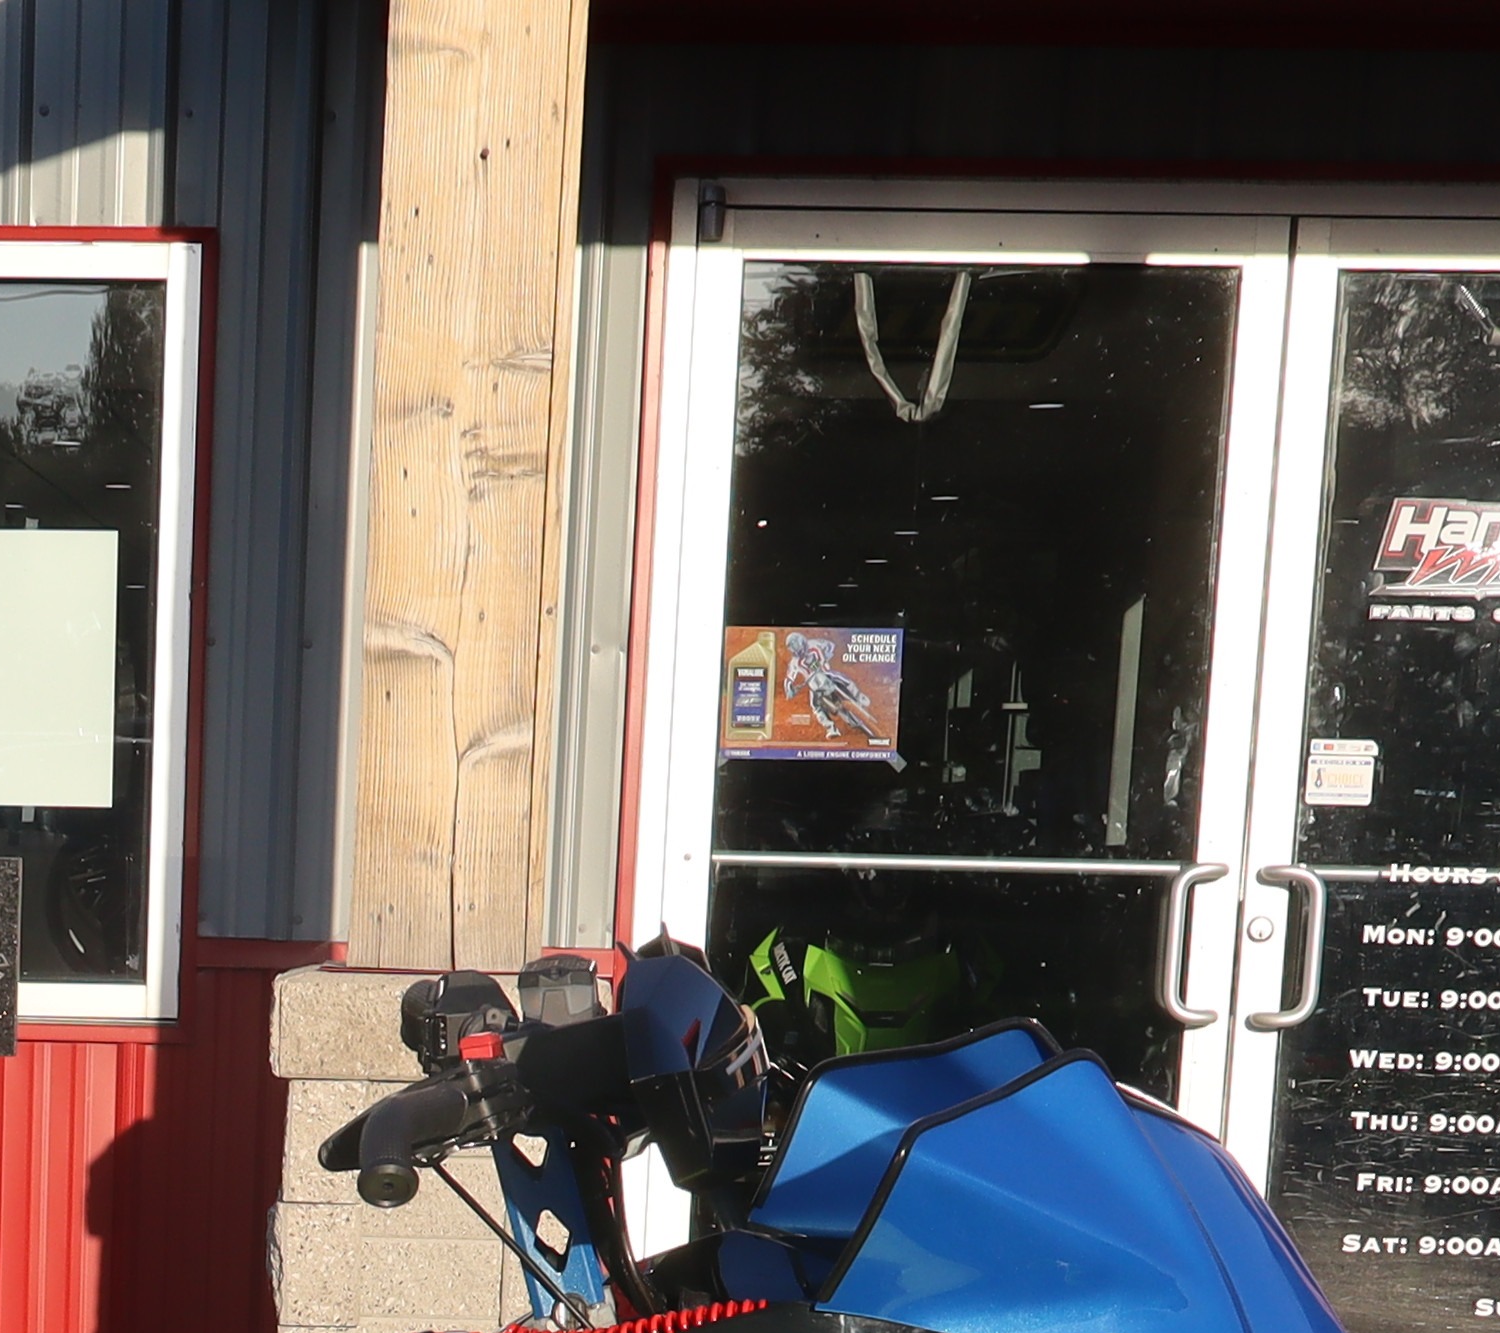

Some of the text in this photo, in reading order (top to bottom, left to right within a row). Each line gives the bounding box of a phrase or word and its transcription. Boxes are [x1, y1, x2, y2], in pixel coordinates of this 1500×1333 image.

[1369, 604, 1476, 621] PARTS
[851, 634, 897, 643] SCHEDULE
[847, 643, 897, 653] YOUR NEXT
[842, 653, 896, 663] OIL CHANGE
[781, 965, 798, 985] CAT
